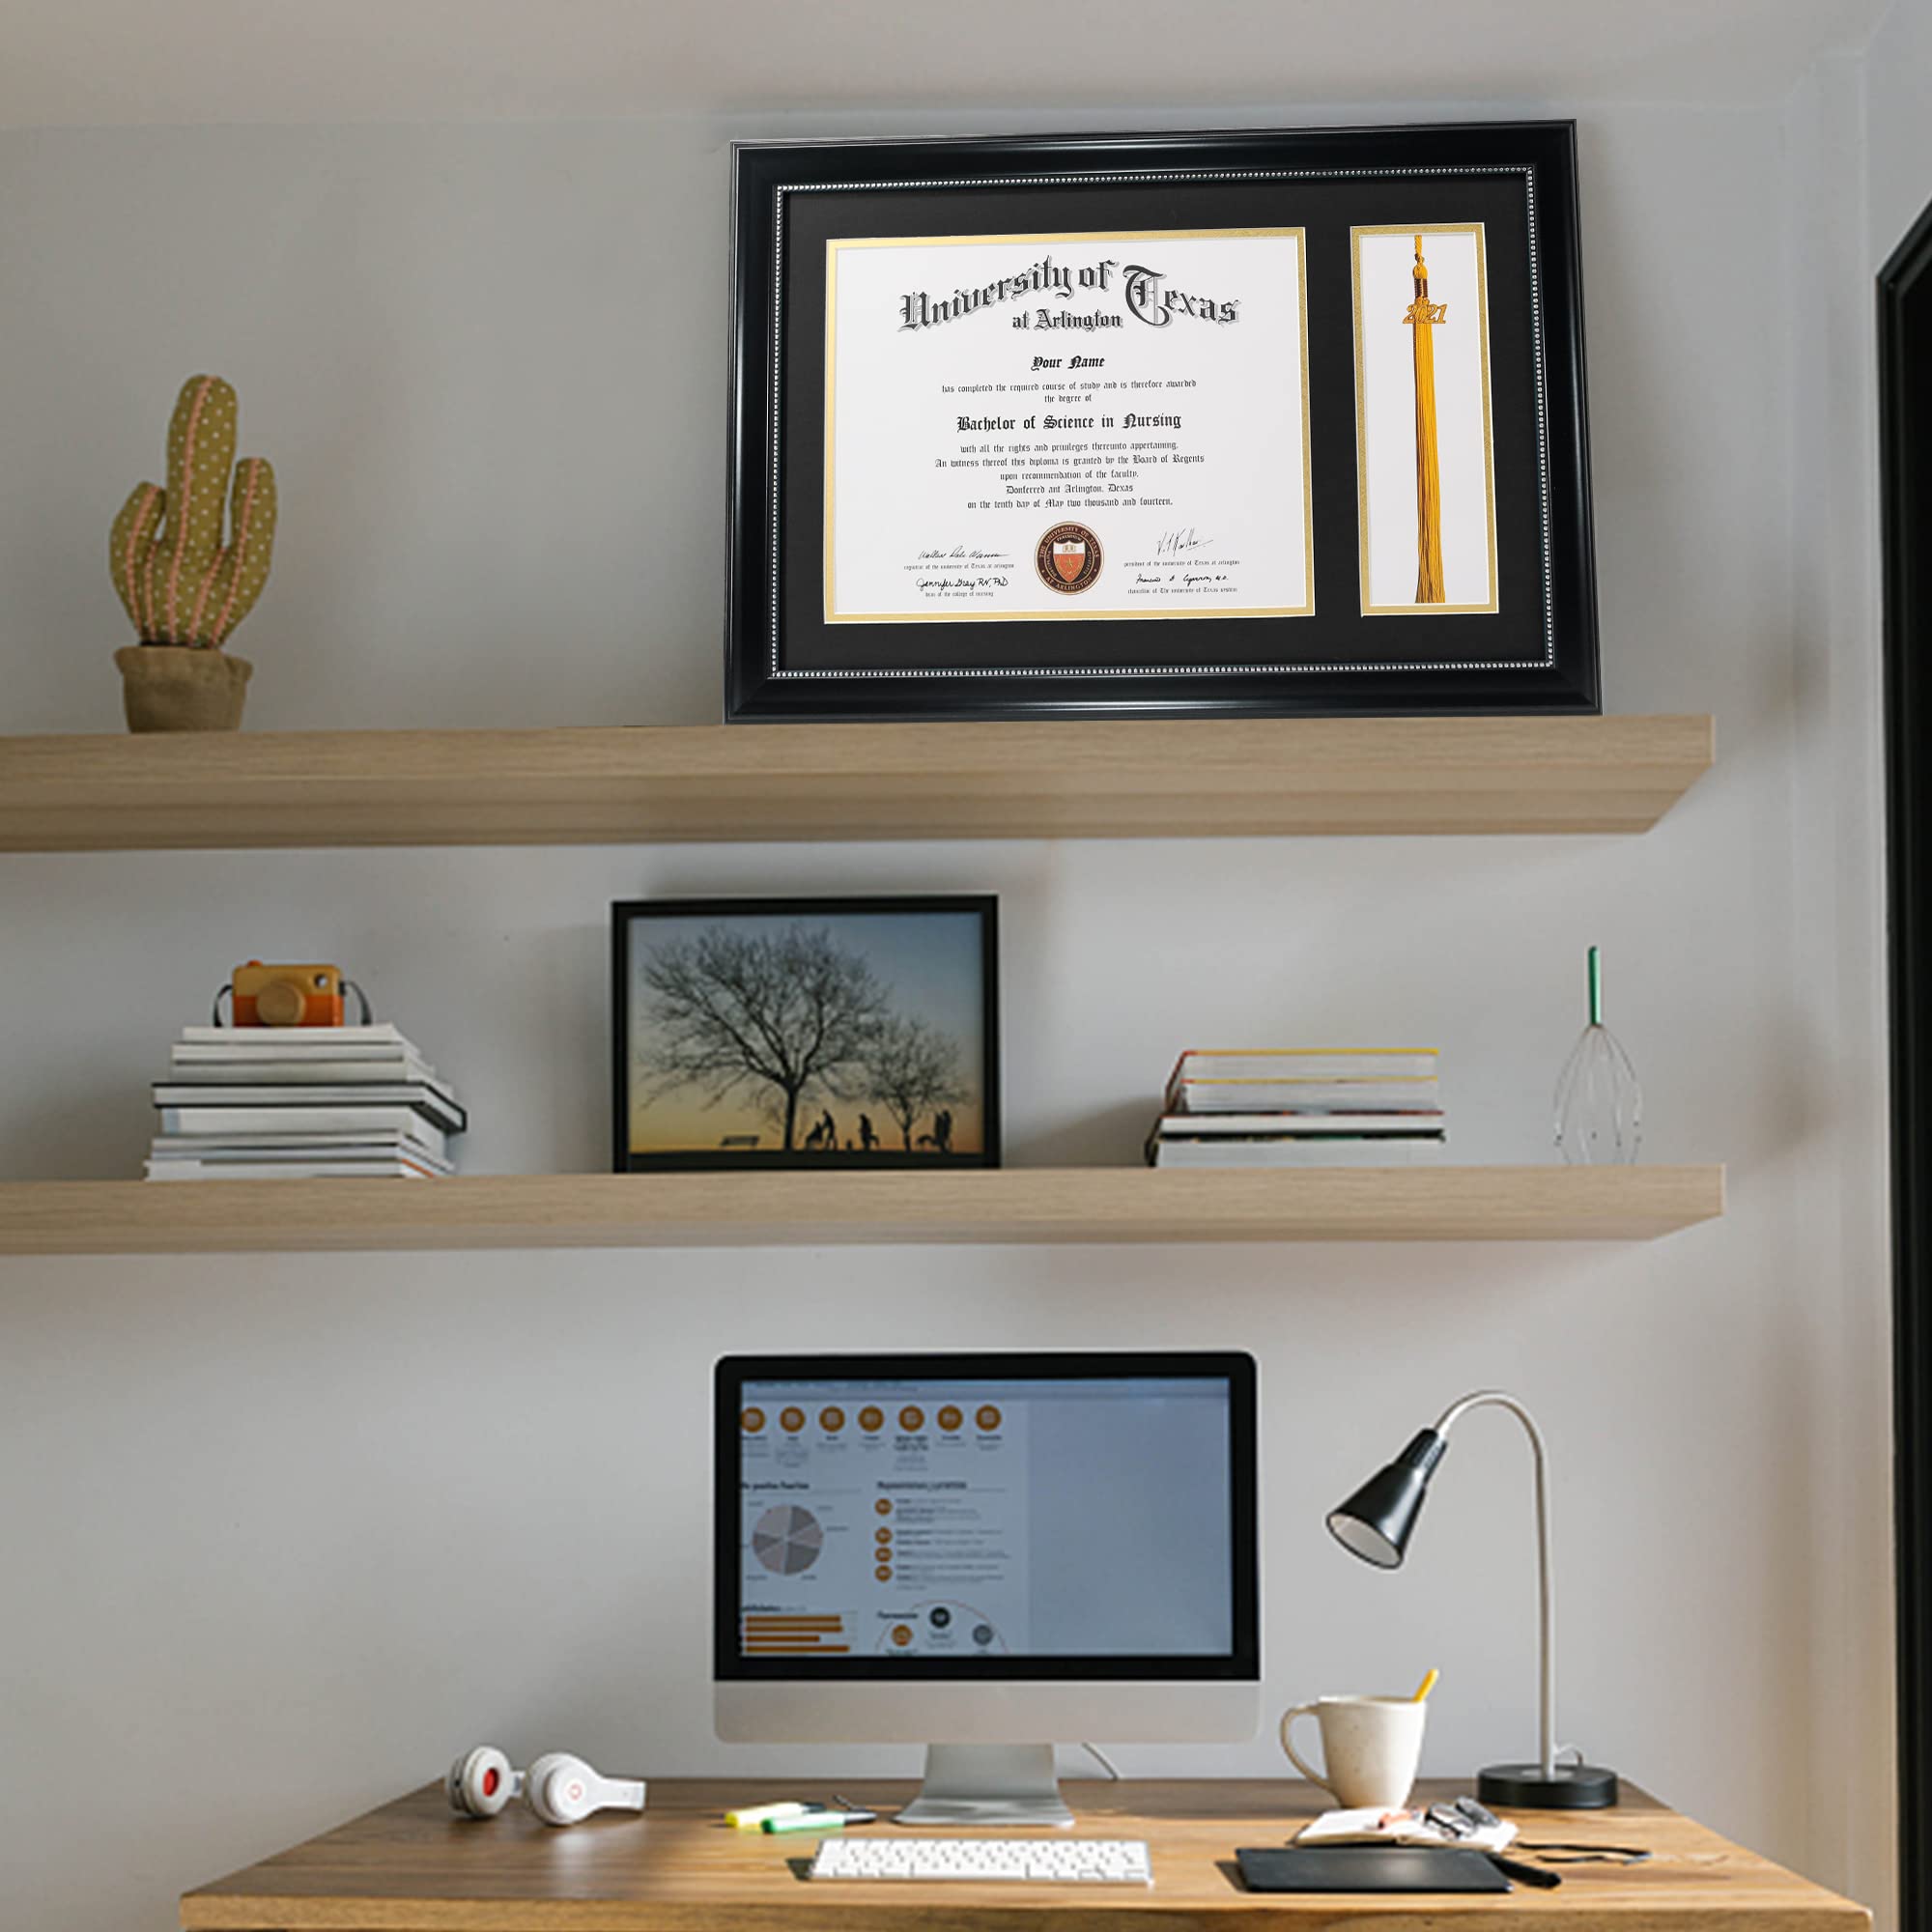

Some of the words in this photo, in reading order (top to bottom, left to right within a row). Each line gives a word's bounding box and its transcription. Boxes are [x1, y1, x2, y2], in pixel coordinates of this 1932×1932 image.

[898, 255, 1072, 331] University
[1078, 259, 1119, 292] of
[1122, 265, 1241, 327] Texas
[1011, 310, 1031, 330] at
[1034, 308, 1123, 332] Arlington
[1403, 303, 1448, 324] 2021
[1031, 356, 1062, 371] Your
[1067, 355, 1106, 370] Name
[942, 384, 955, 393] has
[957, 383, 993, 393] completed
[996, 384, 1007, 392] the
[1009, 383, 1039, 392] required
[1042, 383, 1065, 391] course
[1068, 382, 1076, 390] of
[1080, 381, 1100, 391] study
[1103, 381, 1118, 389] and
[1121, 380, 1127, 388] is
[1131, 380, 1163, 388] therefore
[1166, 379, 1197, 387] awarded
[1044, 394, 1055, 403] the
[1059, 394, 1081, 404] degree
[1085, 393, 1093, 402] of
[956, 415, 1016, 434] Bachelor
[1023, 415, 1037, 430] of
[1043, 414, 1094, 430] Science
[1101, 413, 1114, 428] in
[1122, 412, 1181, 429] Nursing
[960, 444, 977, 454] with
[980, 444, 990, 453] all
[993, 444, 1005, 453] the
[1034, 443, 1048, 452] and
[982, 458, 1008, 467] thereof
[1011, 458, 1025, 467] this
[1030, 457, 1059, 467] diploma
[1073, 456, 1102, 467] granted
[1105, 456, 1115, 466] by
[1118, 455, 1129, 465] the
[1133, 454, 1157, 465] Board
[1160, 454, 1169, 464] of
[1173, 454, 1205, 465] Regents
[1000, 472, 1018, 482] upon
[1021, 470, 1082, 480] recommendation
[1085, 469, 1093, 479] of
[1095, 469, 1107, 479] the
[980, 500, 990, 509] the
[994, 499, 1013, 509] tenth
[1016, 499, 1030, 508] day
[1033, 499, 1040, 508] of
[1045, 498, 1064, 508] May
[1066, 498, 1081, 508] two
[1084, 497, 1119, 508] thousand
[1122, 497, 1136, 507] and
[1044, 526, 1078, 543] UNIVERSITY
[1090, 538, 1099, 557] TEXAS
[1057, 577, 1093, 590] ARLINGTON
